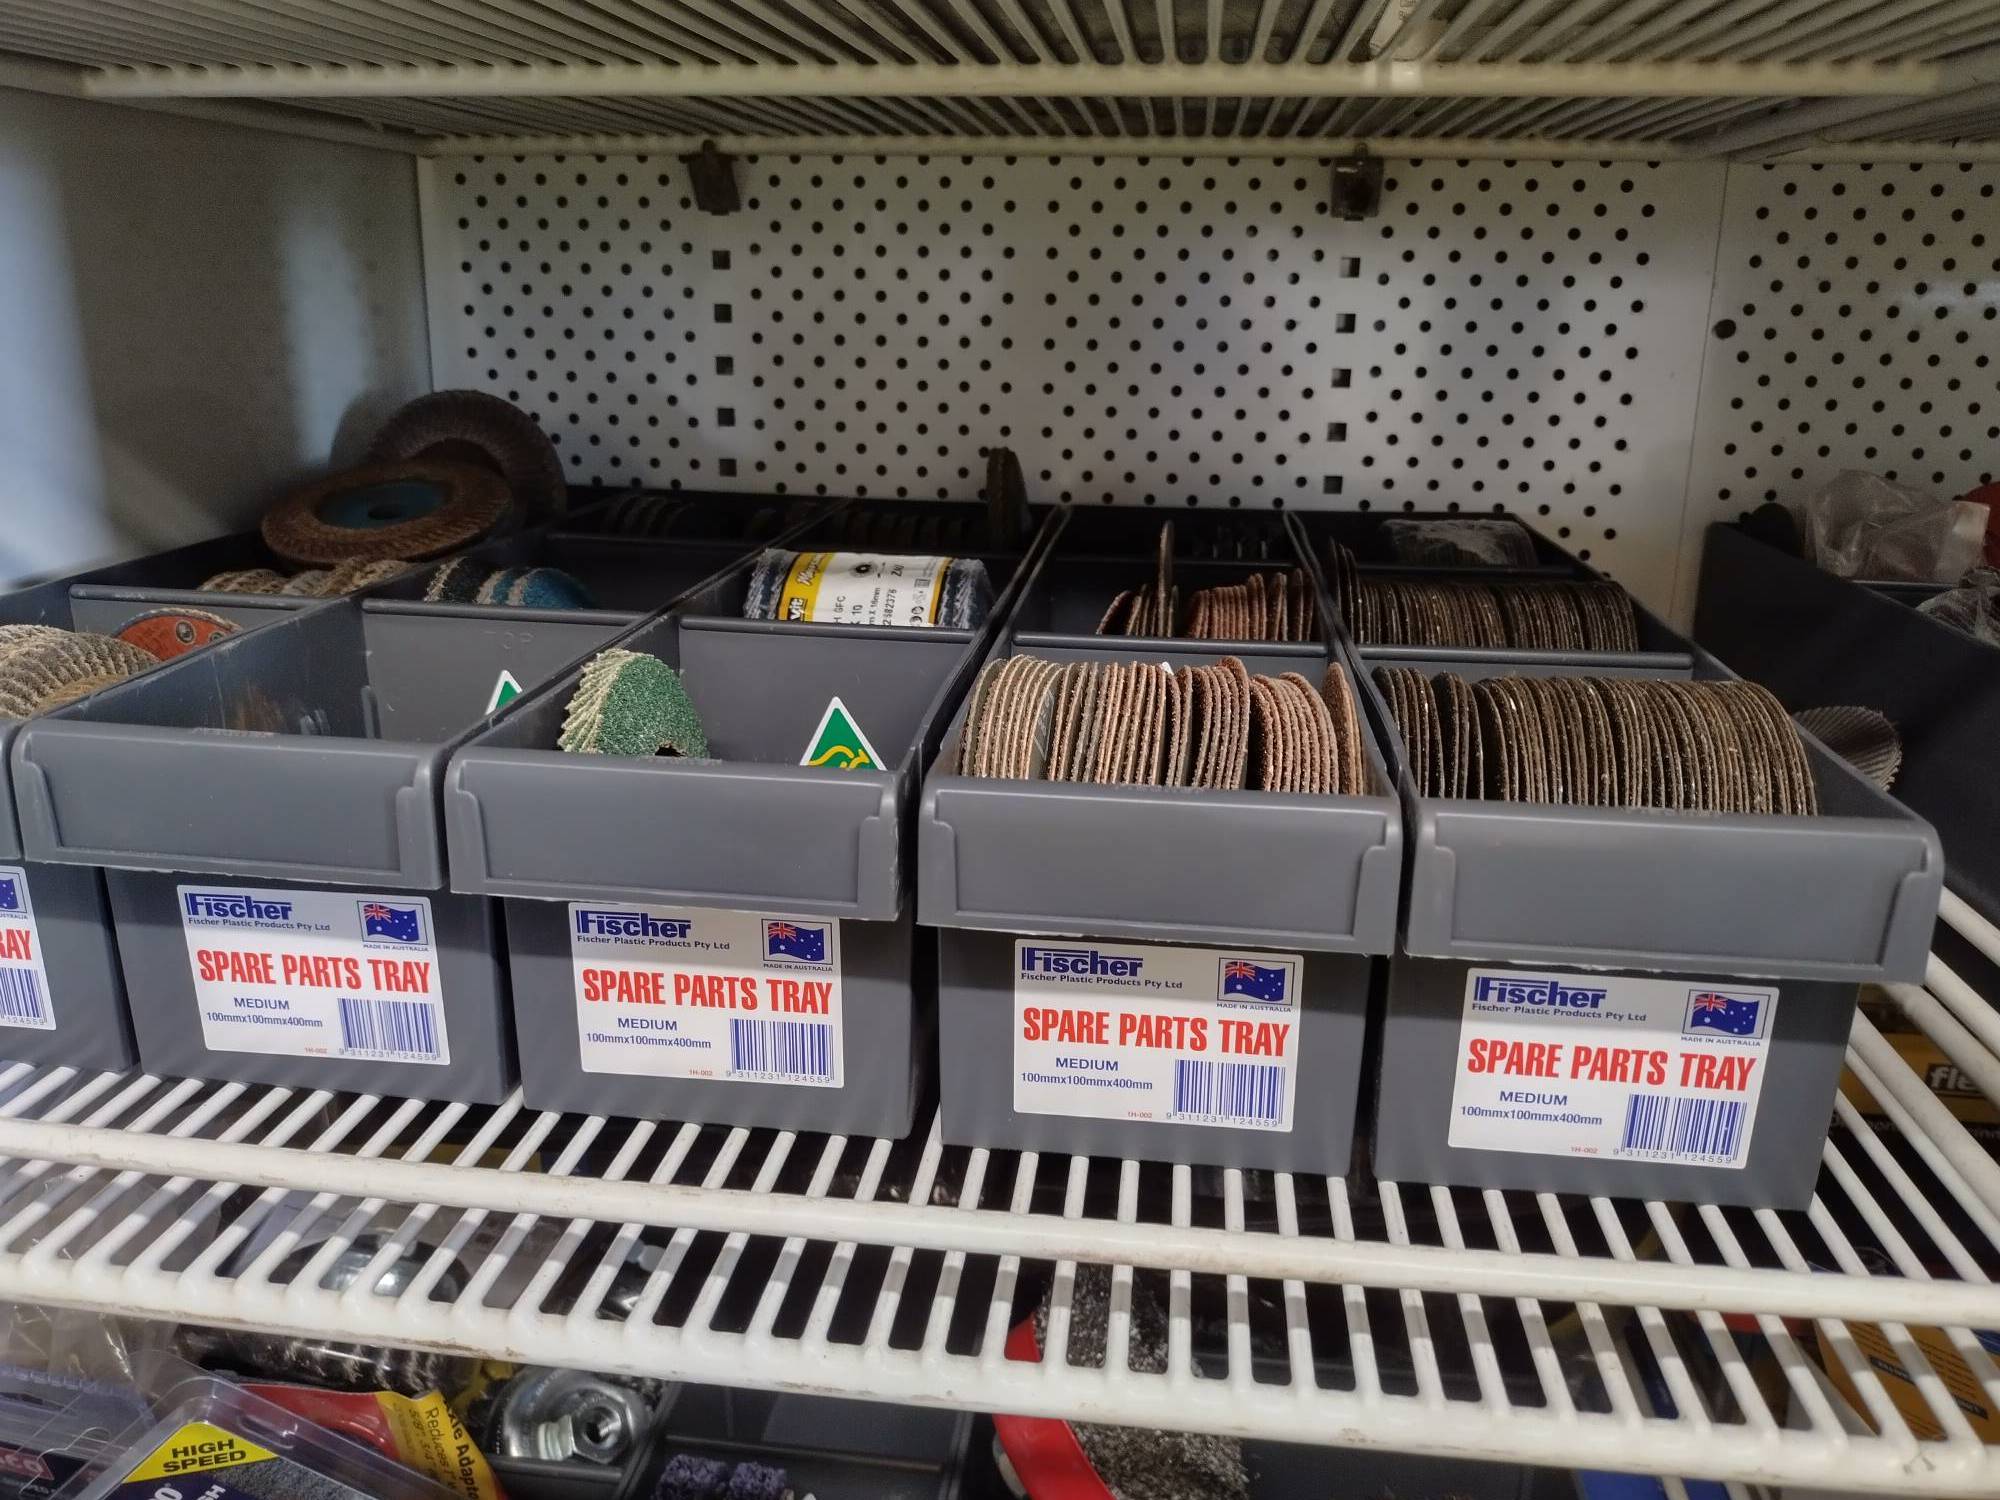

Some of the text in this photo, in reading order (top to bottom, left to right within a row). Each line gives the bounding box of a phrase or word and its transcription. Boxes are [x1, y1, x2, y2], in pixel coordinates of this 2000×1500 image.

[184, 893, 292, 920] Fischer
[188, 917, 330, 931] Fischer Plastic Products Pty Ltd
[576, 909, 692, 939] Fischer
[577, 935, 730, 951] Fischer Plastic Products Pty Ltd
[793, 964, 833, 972] AUSTRALIA
[1021, 946, 1143, 976] Fischer
[197, 949, 430, 994] SPARE PARTS TRAY
[1021, 973, 1183, 989] Fischer Plastic Products Pty Ltd
[582, 968, 833, 1015] SPARE PARTS TRAY
[1474, 976, 1607, 1009] Fischer
[234, 997, 290, 1010] MEDIUM
[1249, 1004, 1292, 1013] AUSTRALIA
[1472, 1003, 1647, 1022] Fischer Plastic Products Pty Ltd
[206, 1012, 323, 1028] 100mmx100mmx400mm
[617, 1017, 678, 1031] MEDIUM
[586, 1033, 711, 1049] 100mmx100mmx400mm
[1023, 1007, 1290, 1057] SPARE PARTS TRAY
[1716, 1038, 1761, 1047] AUSTRALIA
[1055, 1057, 1119, 1072] MEDIUM
[1467, 1038, 1757, 1092] SPARE PARTS TRAY
[1021, 1072, 1153, 1090] 100mmx100mmx400mm
[1499, 1090, 1568, 1106] MEDIUM
[1461, 1106, 1603, 1126] 100mmx100mmx400mm
[171, 1438, 234, 1458] HIGH
[163, 1450, 246, 1472] SPEED
